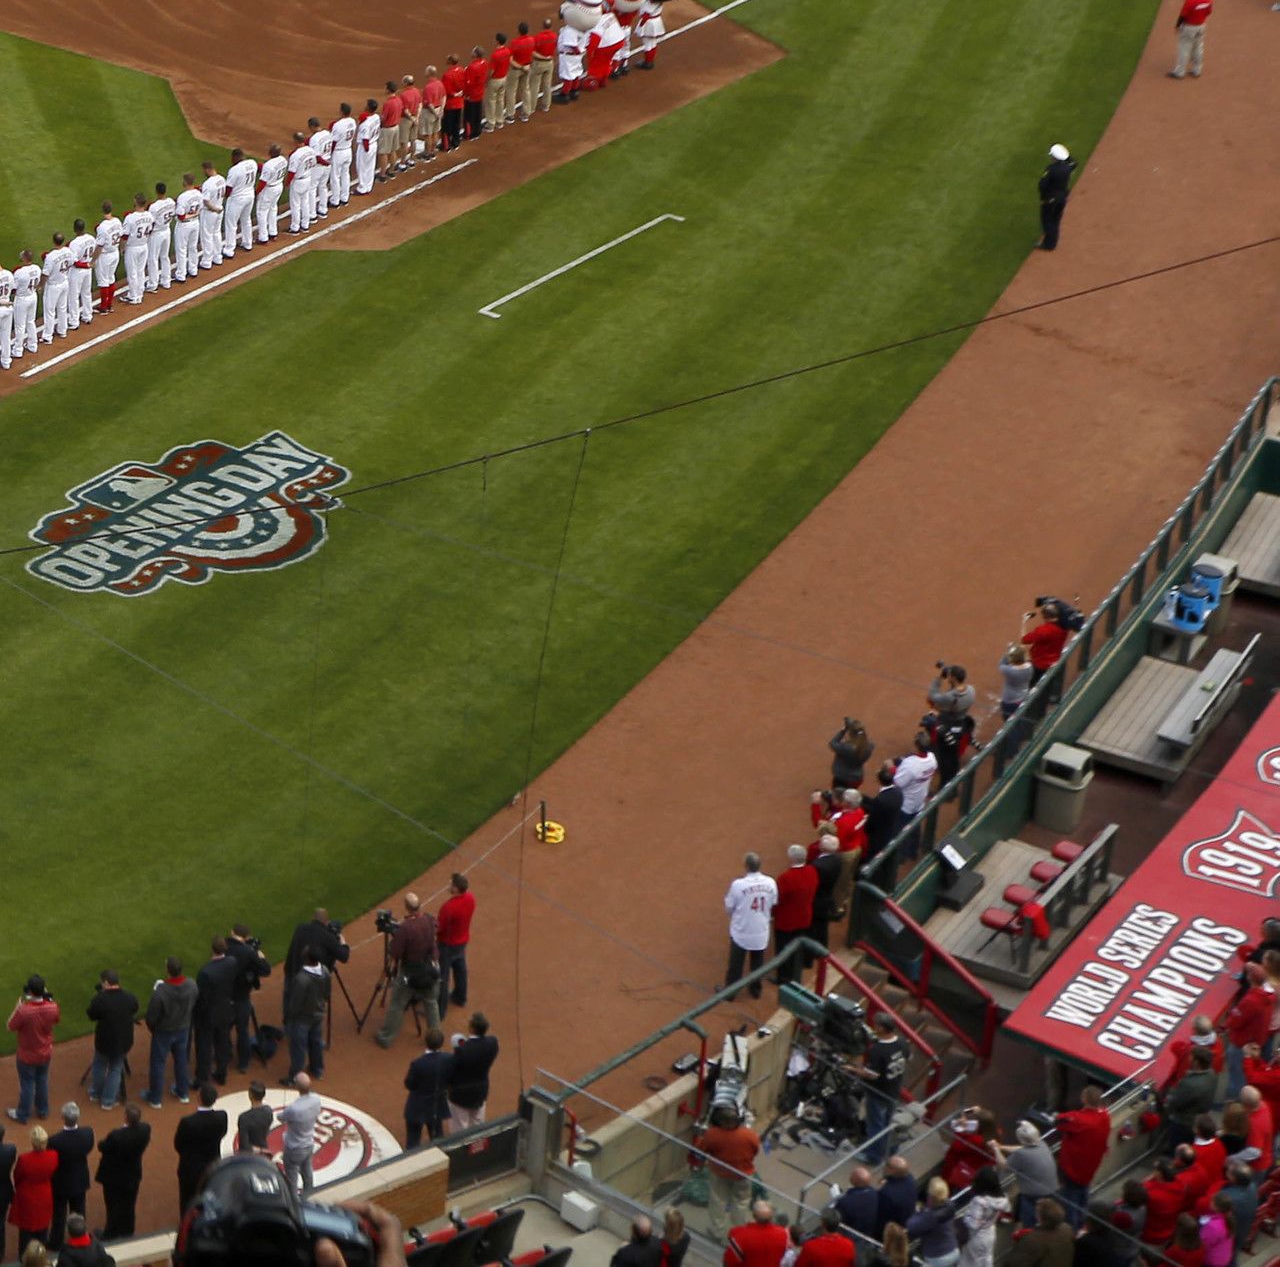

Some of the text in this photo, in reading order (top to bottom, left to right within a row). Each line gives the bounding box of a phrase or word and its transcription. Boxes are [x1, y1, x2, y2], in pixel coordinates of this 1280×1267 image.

[39, 436, 320, 587] OPENING DAY
[750, 896, 766, 913] 41
[1198, 830, 1280, 888] 1919
[1044, 903, 1179, 1028] WORLD SERIES
[1097, 917, 1247, 1060] CHAMPIONS
